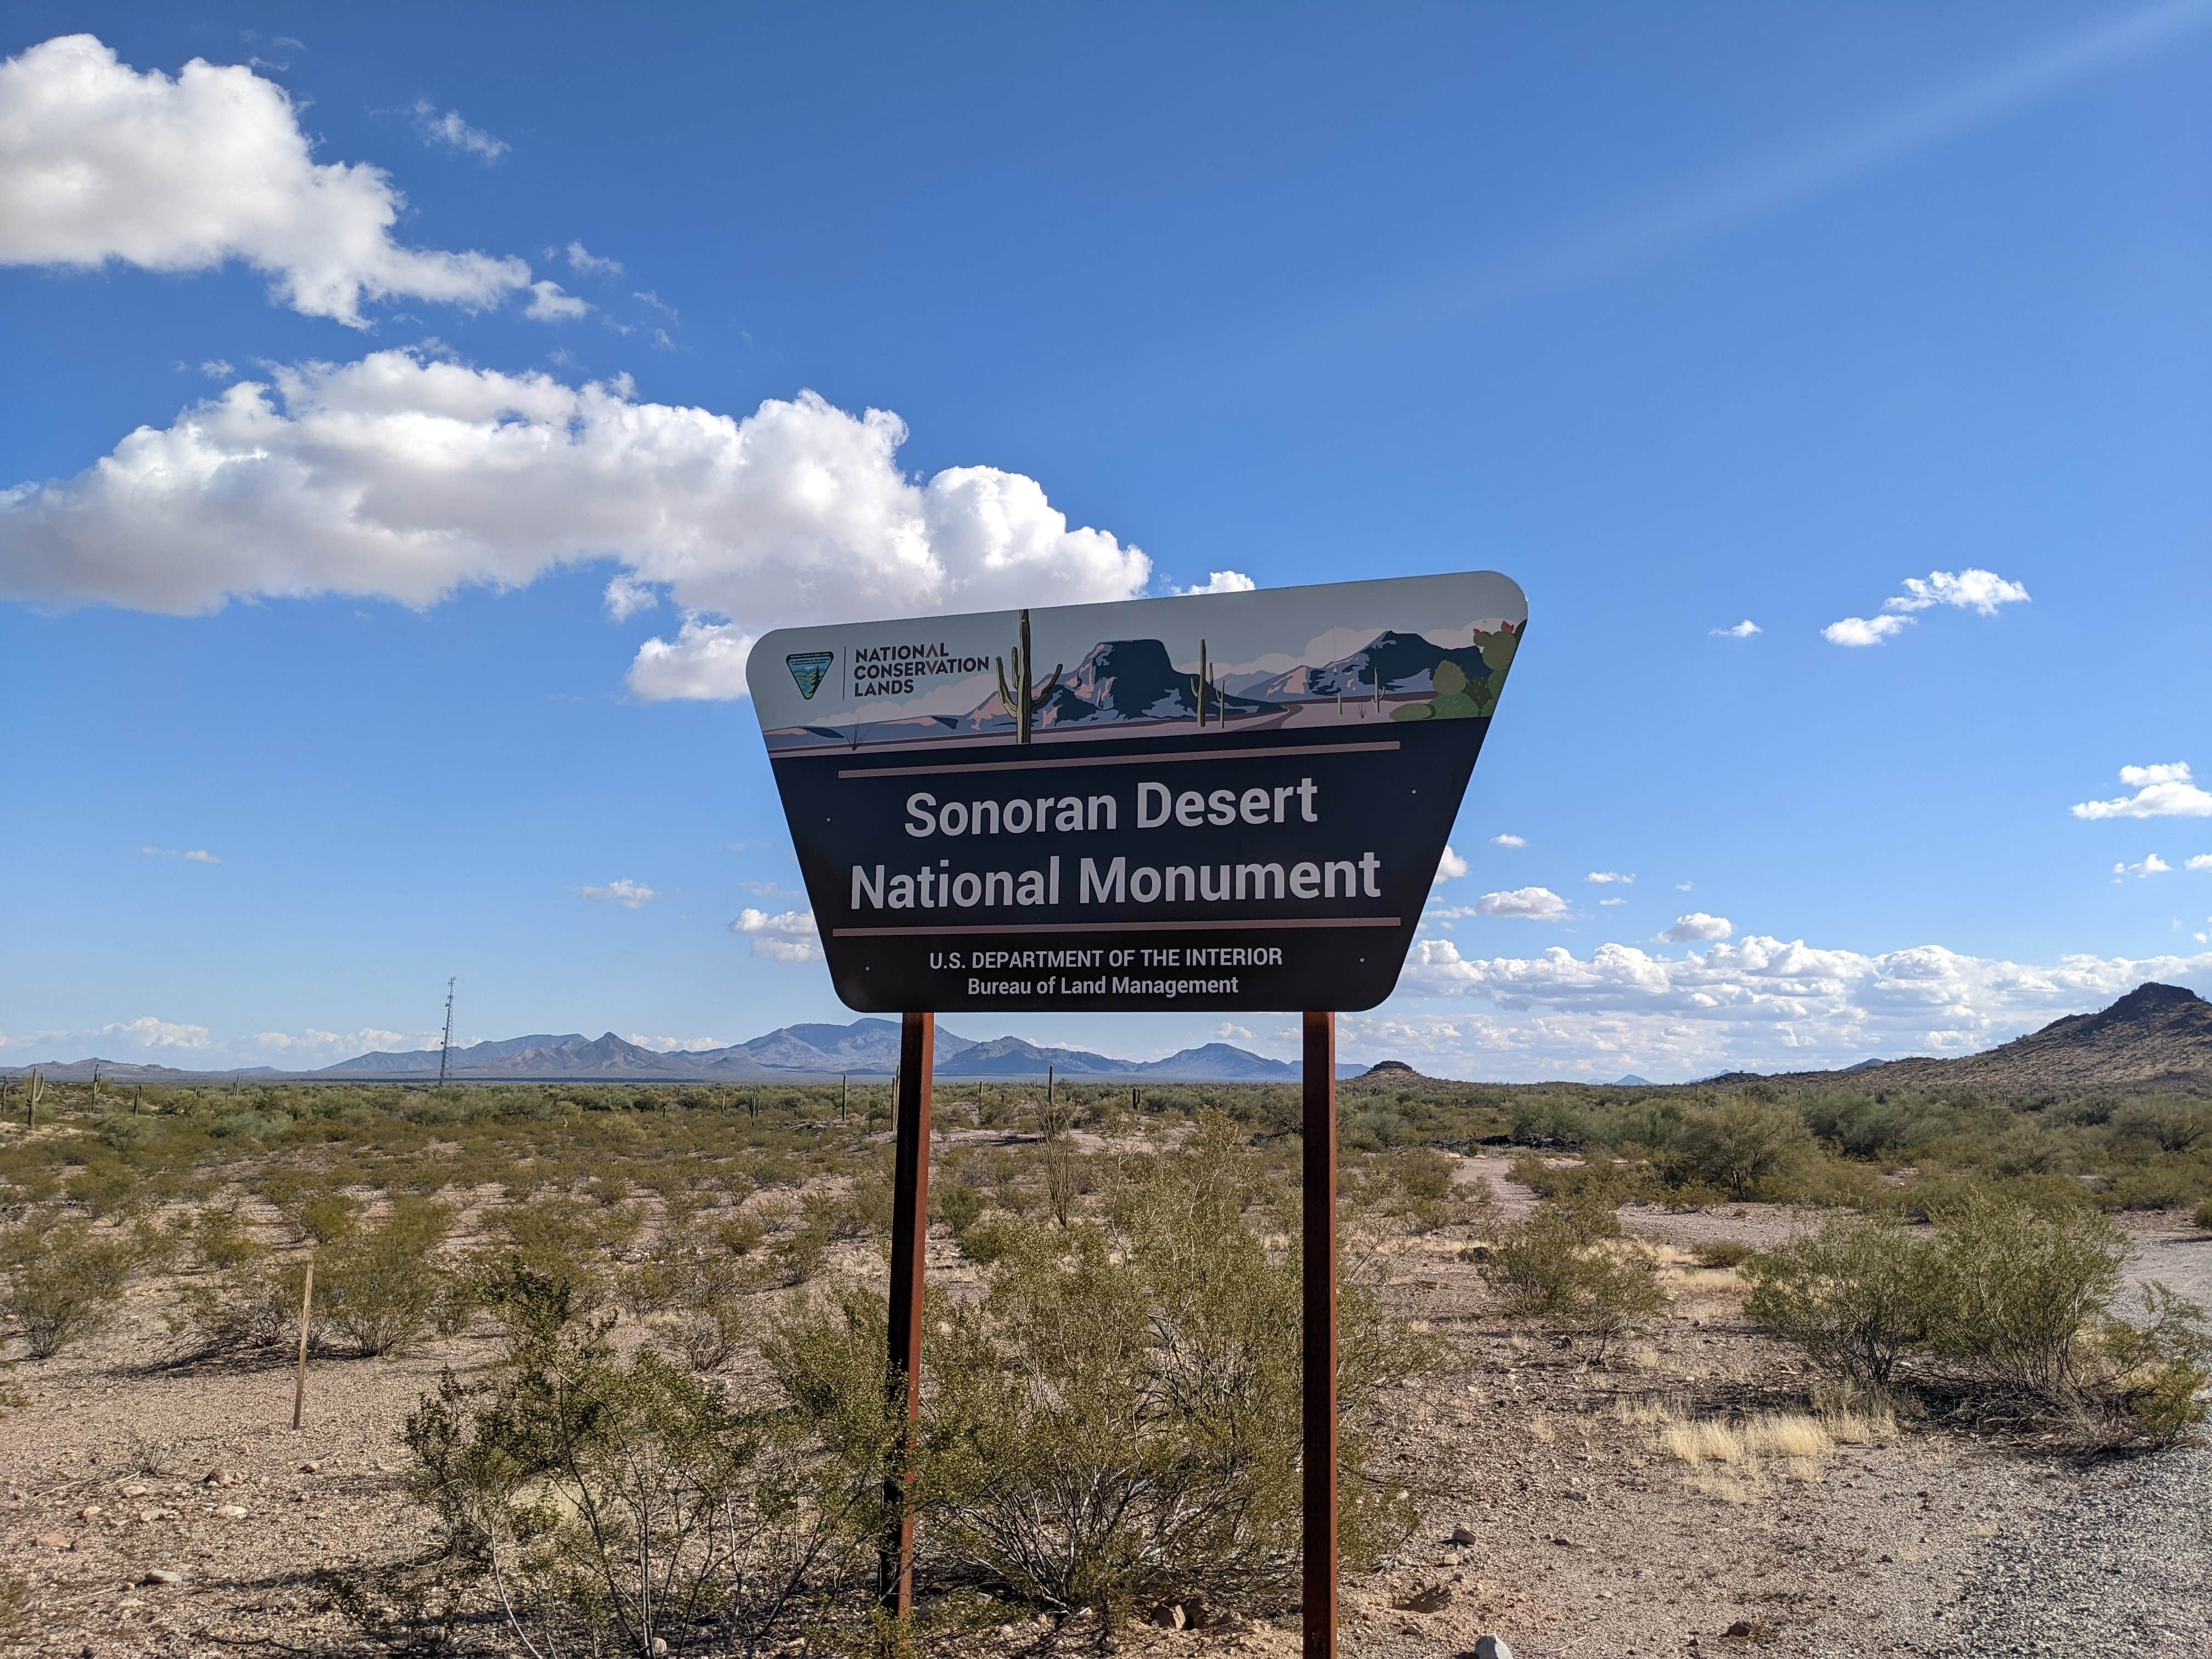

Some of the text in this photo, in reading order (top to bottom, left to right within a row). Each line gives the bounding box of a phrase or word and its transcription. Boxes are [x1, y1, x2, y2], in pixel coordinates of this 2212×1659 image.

[855, 642, 949, 663] NATIONAL
[854, 657, 989, 680] CONSERVATION
[854, 679, 914, 697] LANDS
[905, 777, 1318, 837] Sonoran Desert
[851, 851, 1381, 910] National Monument
[930, 947, 1283, 969] U.S. DEPARTMENT OF THE INTERIOR
[968, 975, 1239, 998] Bureau of Land Management
